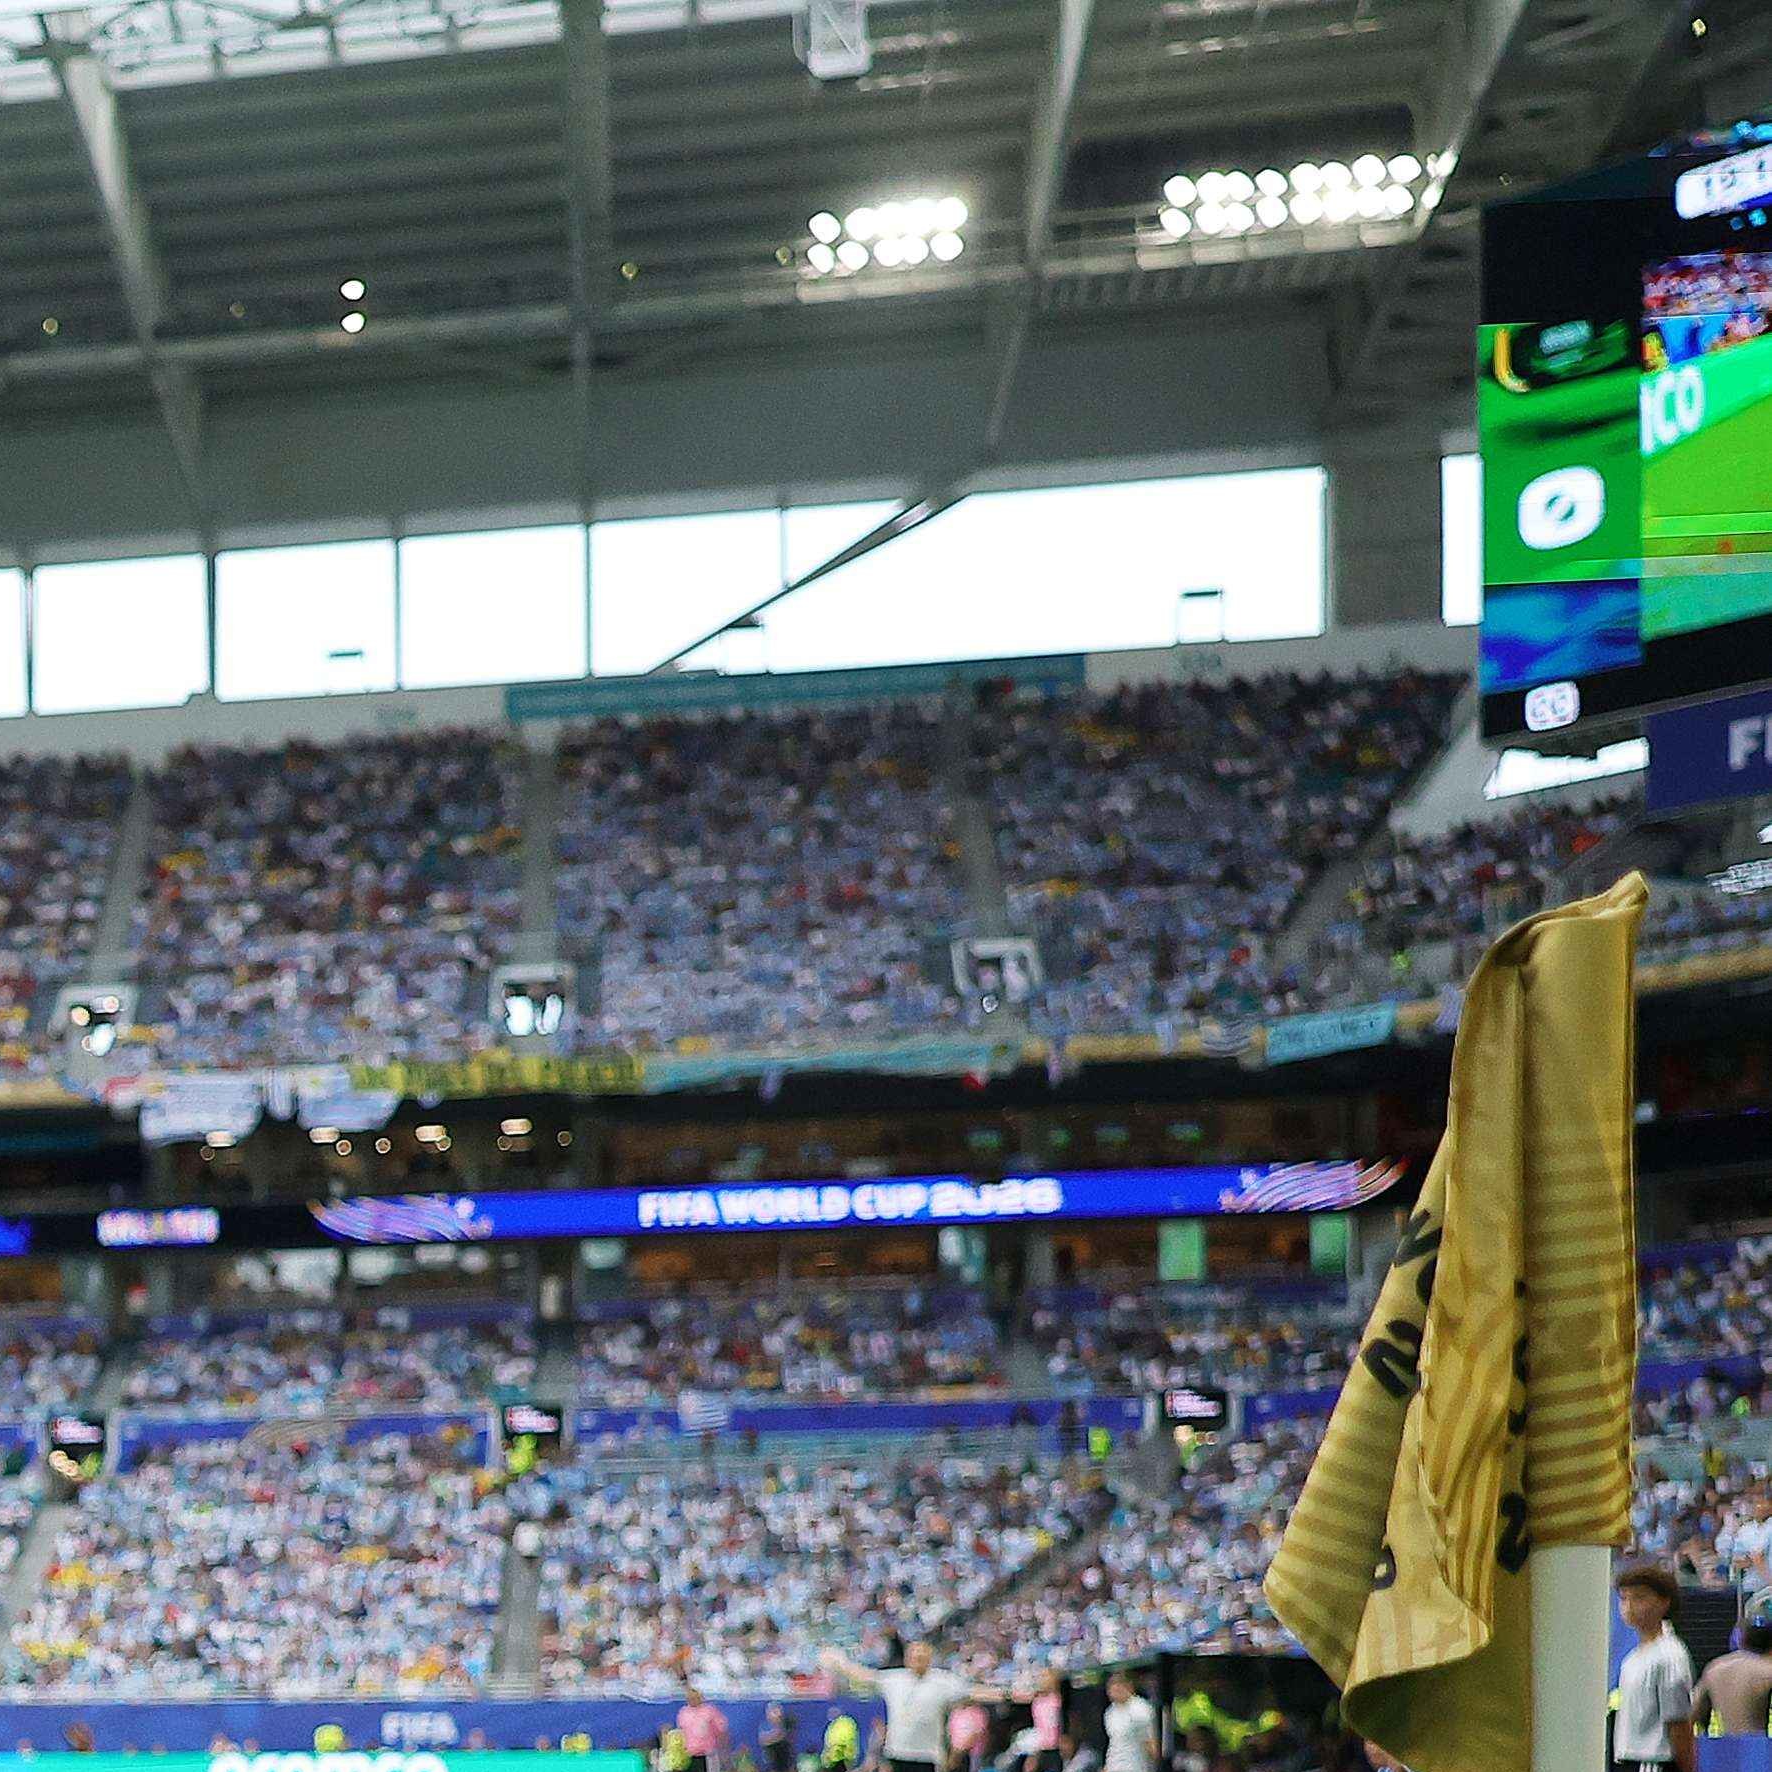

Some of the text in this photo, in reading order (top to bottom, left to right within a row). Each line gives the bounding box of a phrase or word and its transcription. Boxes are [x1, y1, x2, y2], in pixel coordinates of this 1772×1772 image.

[637, 1190, 716, 1228] FIFA
[717, 1185, 849, 1225] WORLD
[851, 1183, 927, 1220] CUP
